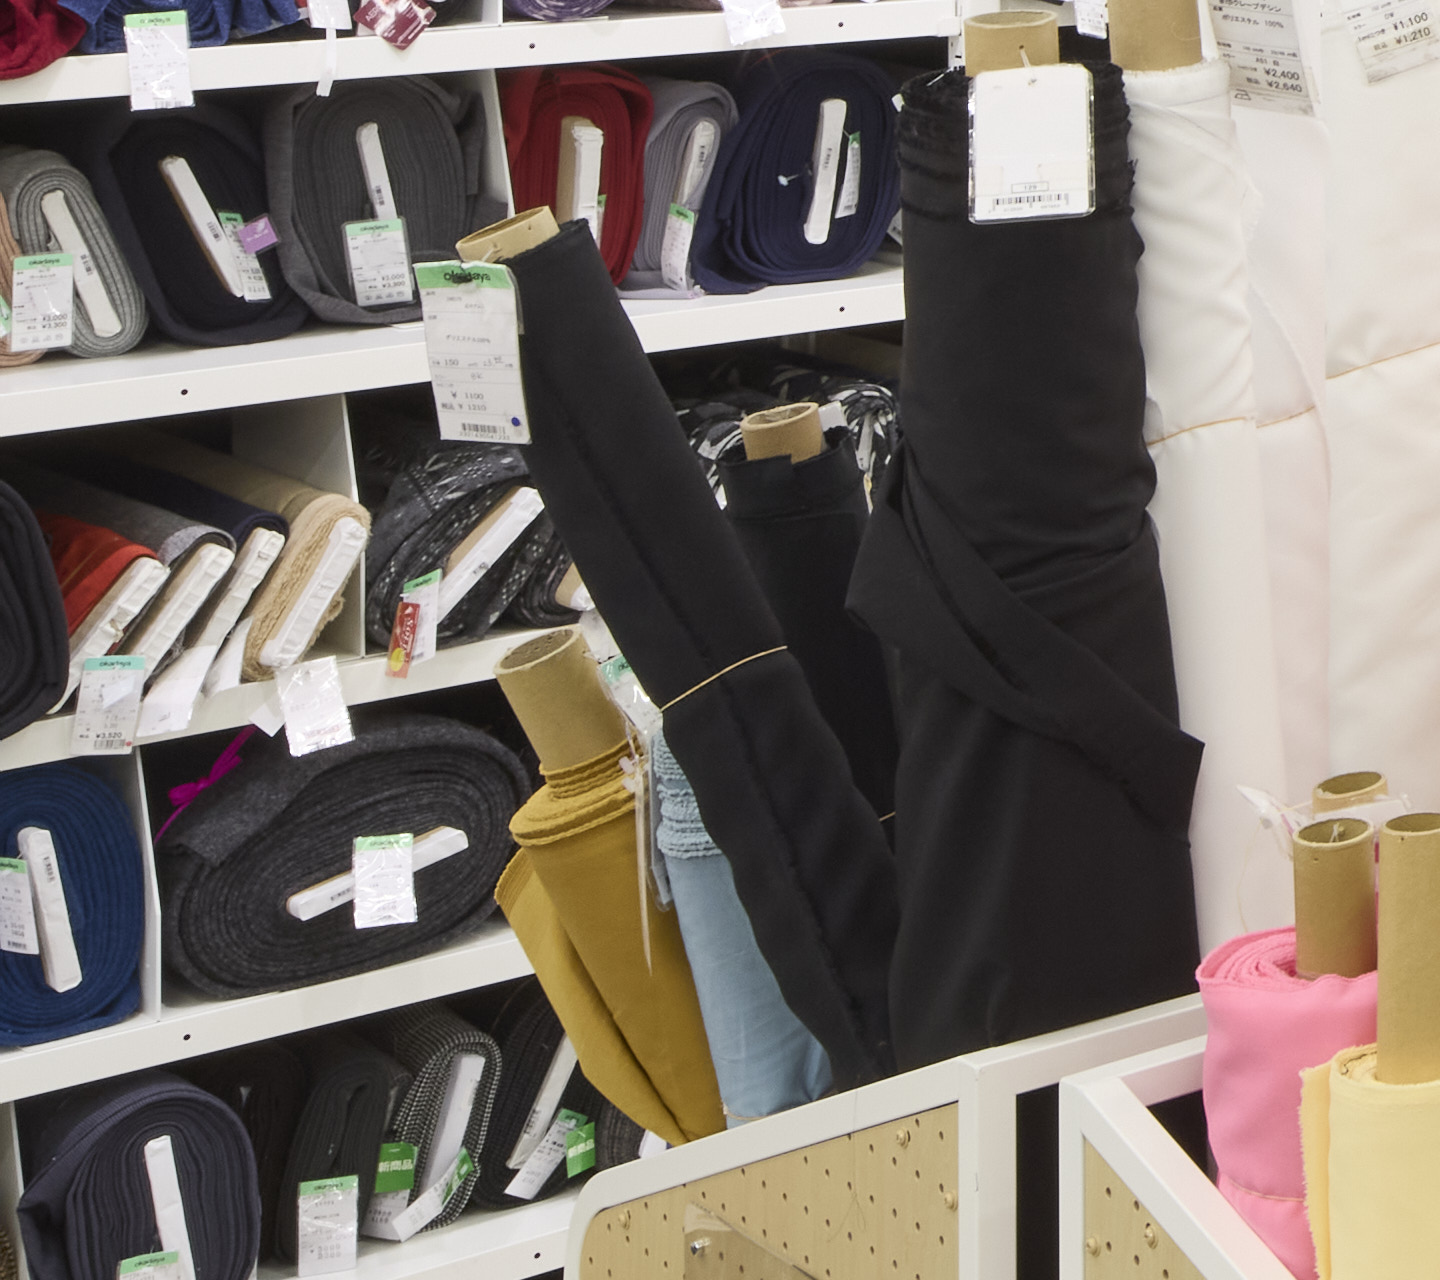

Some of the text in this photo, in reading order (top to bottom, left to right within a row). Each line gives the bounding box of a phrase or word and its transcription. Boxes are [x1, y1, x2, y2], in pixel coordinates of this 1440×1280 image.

[1393, 12, 1428, 31] ¥1,100
[1395, 27, 1431, 45] ¥1,210
[1264, 67, 1300, 81] ¥2,400
[1267, 81, 1302, 94] ¥2,640
